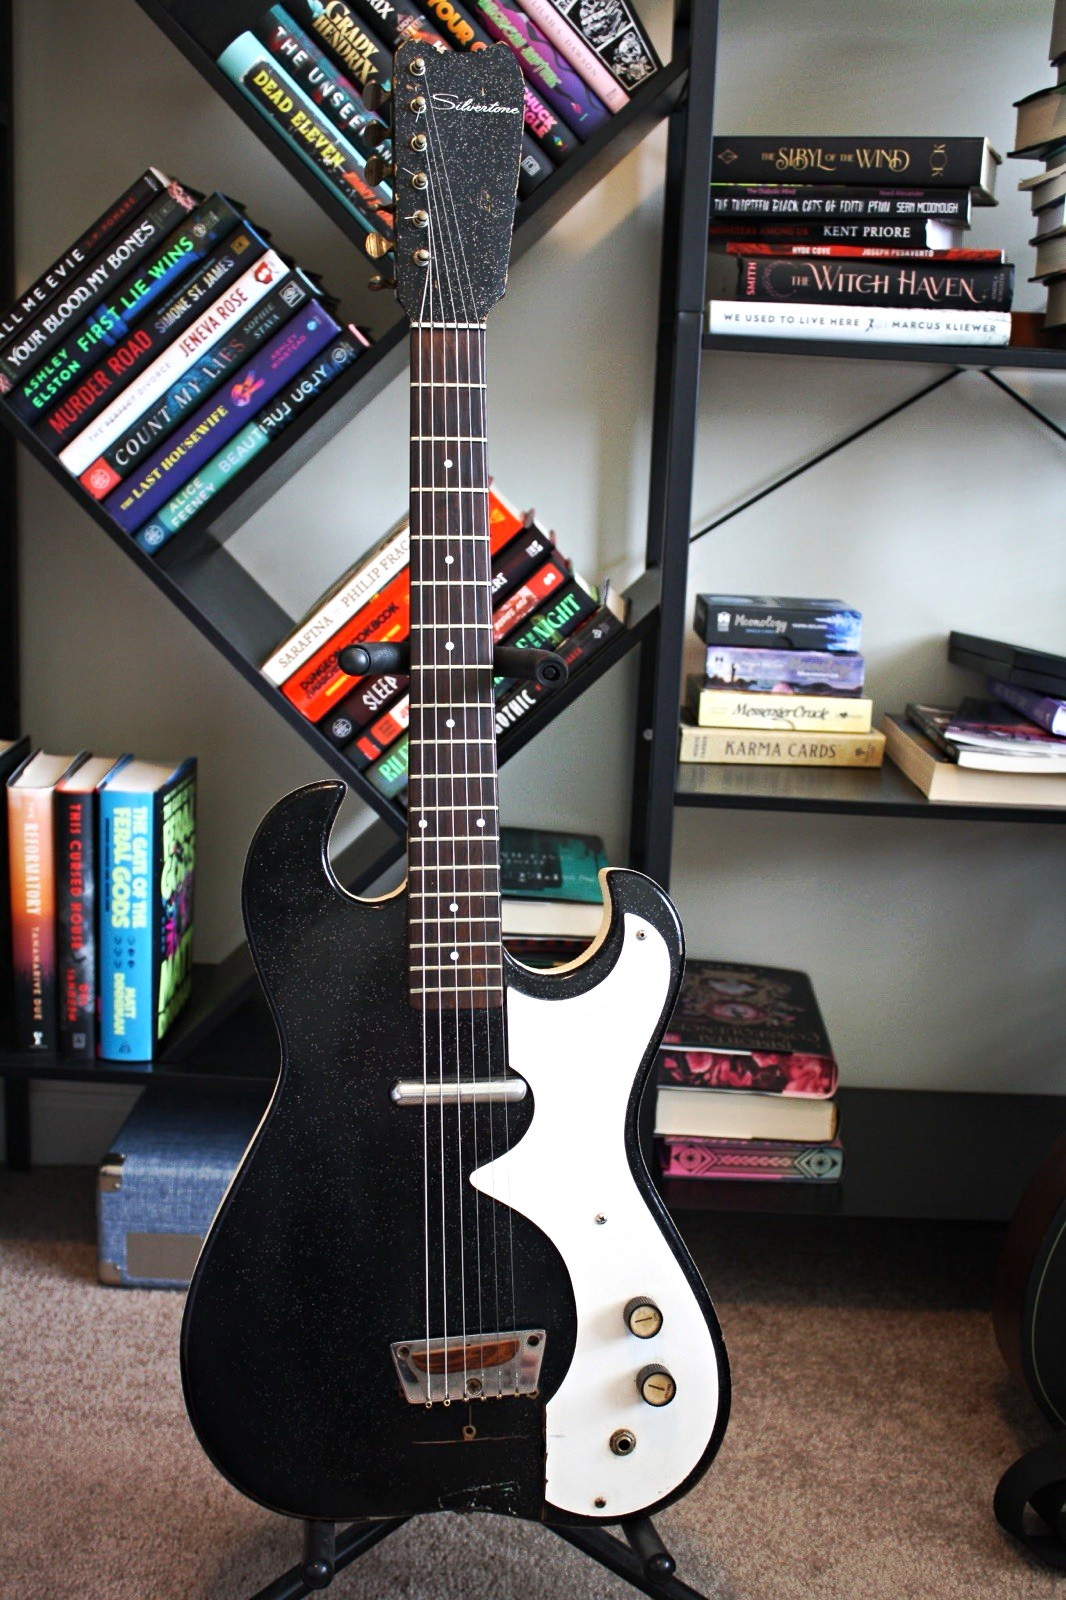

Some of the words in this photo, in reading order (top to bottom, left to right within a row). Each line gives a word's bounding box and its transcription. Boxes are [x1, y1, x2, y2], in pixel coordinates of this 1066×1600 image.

[312, 14, 379, 85] HENDRIX
[325, 0, 380, 60] GRADY
[275, 25, 309, 67] THE
[308, 66, 366, 137] UNSEE
[252, 69, 294, 114] DEAD
[290, 110, 346, 169] ELEVEN
[431, 93, 520, 115] Silvertone
[761, 152, 775, 161] THE
[775, 147, 837, 171] SIBYL
[825, 153, 837, 162] OF
[840, 153, 854, 162] THE
[855, 149, 910, 172] WIND
[802, 200, 822, 212] CATS
[825, 200, 837, 212] OF
[896, 201, 916, 213] SEAN
[823, 225, 858, 237] KENT
[862, 226, 911, 239] PRIORE
[7, 329, 47, 367] YOUR
[86, 264, 110, 293] MY
[107, 220, 156, 270] BONES
[22, 286, 46, 313] ME
[45, 248, 85, 289] EVIE
[76, 306, 121, 353] FIRST
[120, 278, 150, 310] LIE
[147, 236, 195, 280] WINS
[154, 293, 193, 334] SIMONE
[187, 285, 207, 302] ST.
[203, 255, 235, 288] JAMES
[746, 262, 757, 295] SMITH
[791, 275, 809, 286] THE
[178, 315, 221, 357] JENEVA
[217, 287, 248, 321] ROSE
[243, 303, 276, 334] SOPHIE
[253, 313, 280, 340] STAVA
[724, 313, 740, 322] WE
[745, 314, 775, 323] USED
[780, 315, 795, 323] TO
[799, 317, 825, 325] LIVE
[830, 318, 860, 327] HERE
[892, 320, 941, 330] MARCUS
[945, 322, 997, 333] KLIEWER
[23, 347, 69, 397] ASHLEY
[32, 360, 82, 409] ELSTON
[48, 370, 113, 436] MURDER
[107, 329, 153, 377] ROAD
[115, 405, 172, 466] COUNT
[173, 377, 201, 410] MY
[202, 338, 246, 379] LIES
[120, 497, 134, 511] THE
[131, 467, 163, 500] LAST
[160, 404, 229, 472] HOUSEWIFE
[169, 477, 204, 514] ALICE
[170, 482, 216, 529] FEENEY
[341, 567, 381, 608] PHILIP
[278, 615, 334, 668] SARAFINA
[531, 593, 581, 648] NIGHT
[734, 613, 788, 634] Moonology
[362, 675, 398, 711] SLEEP
[725, 740, 781, 757] KARMA
[788, 743, 836, 758] CARDS
[69, 803, 82, 834] THIS
[113, 806, 132, 865] FERAL
[132, 806, 148, 835] THE
[24, 823, 41, 916] REFORMATORY
[69, 840, 83, 897] CURSED
[132, 836, 148, 875] GATE
[111, 866, 131, 929] GODS
[132, 876, 148, 899] OF
[70, 902, 84, 949] HOUSE
[131, 900, 148, 929] THE
[33, 998, 42, 1020] DUE
